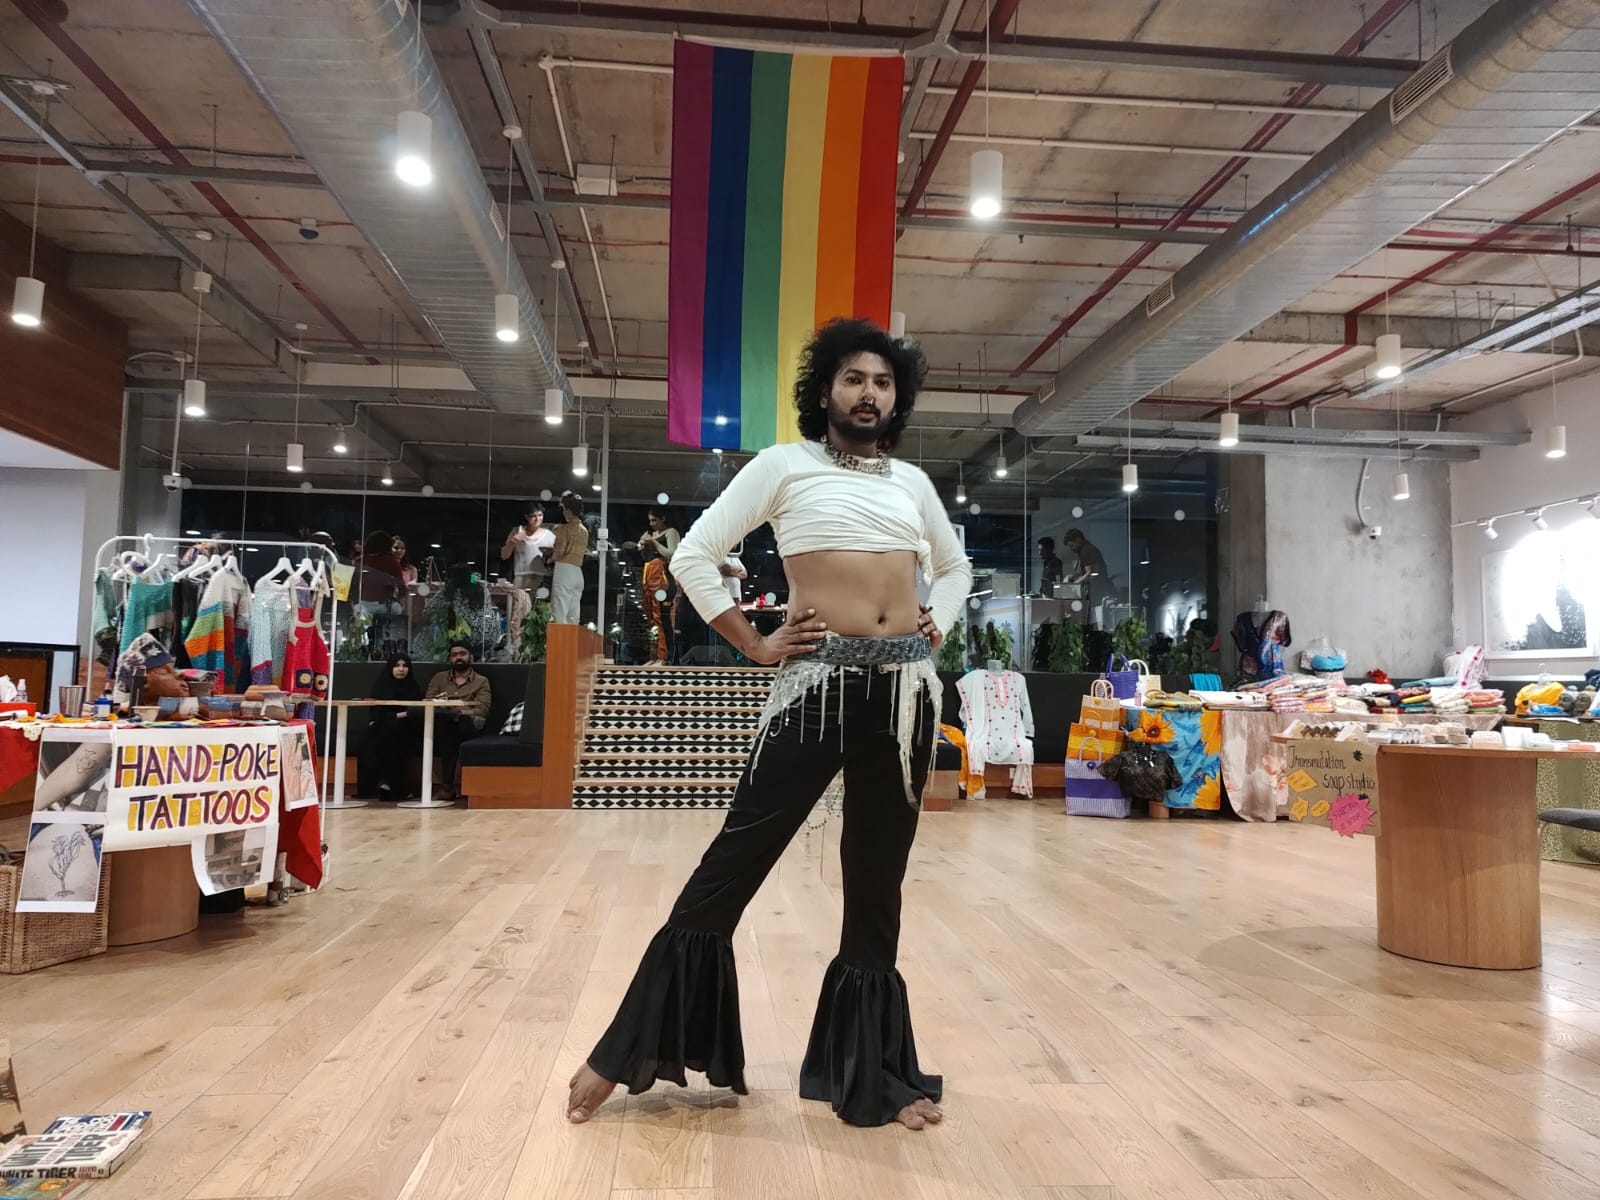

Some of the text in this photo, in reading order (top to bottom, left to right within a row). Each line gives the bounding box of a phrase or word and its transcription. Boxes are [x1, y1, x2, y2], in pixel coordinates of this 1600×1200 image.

[115, 743, 279, 788] HAND-POKE
[129, 785, 270, 831] TATTOOS
[53, 1134, 118, 1165] TIGER
[37, 1167, 77, 1179] TIGER
